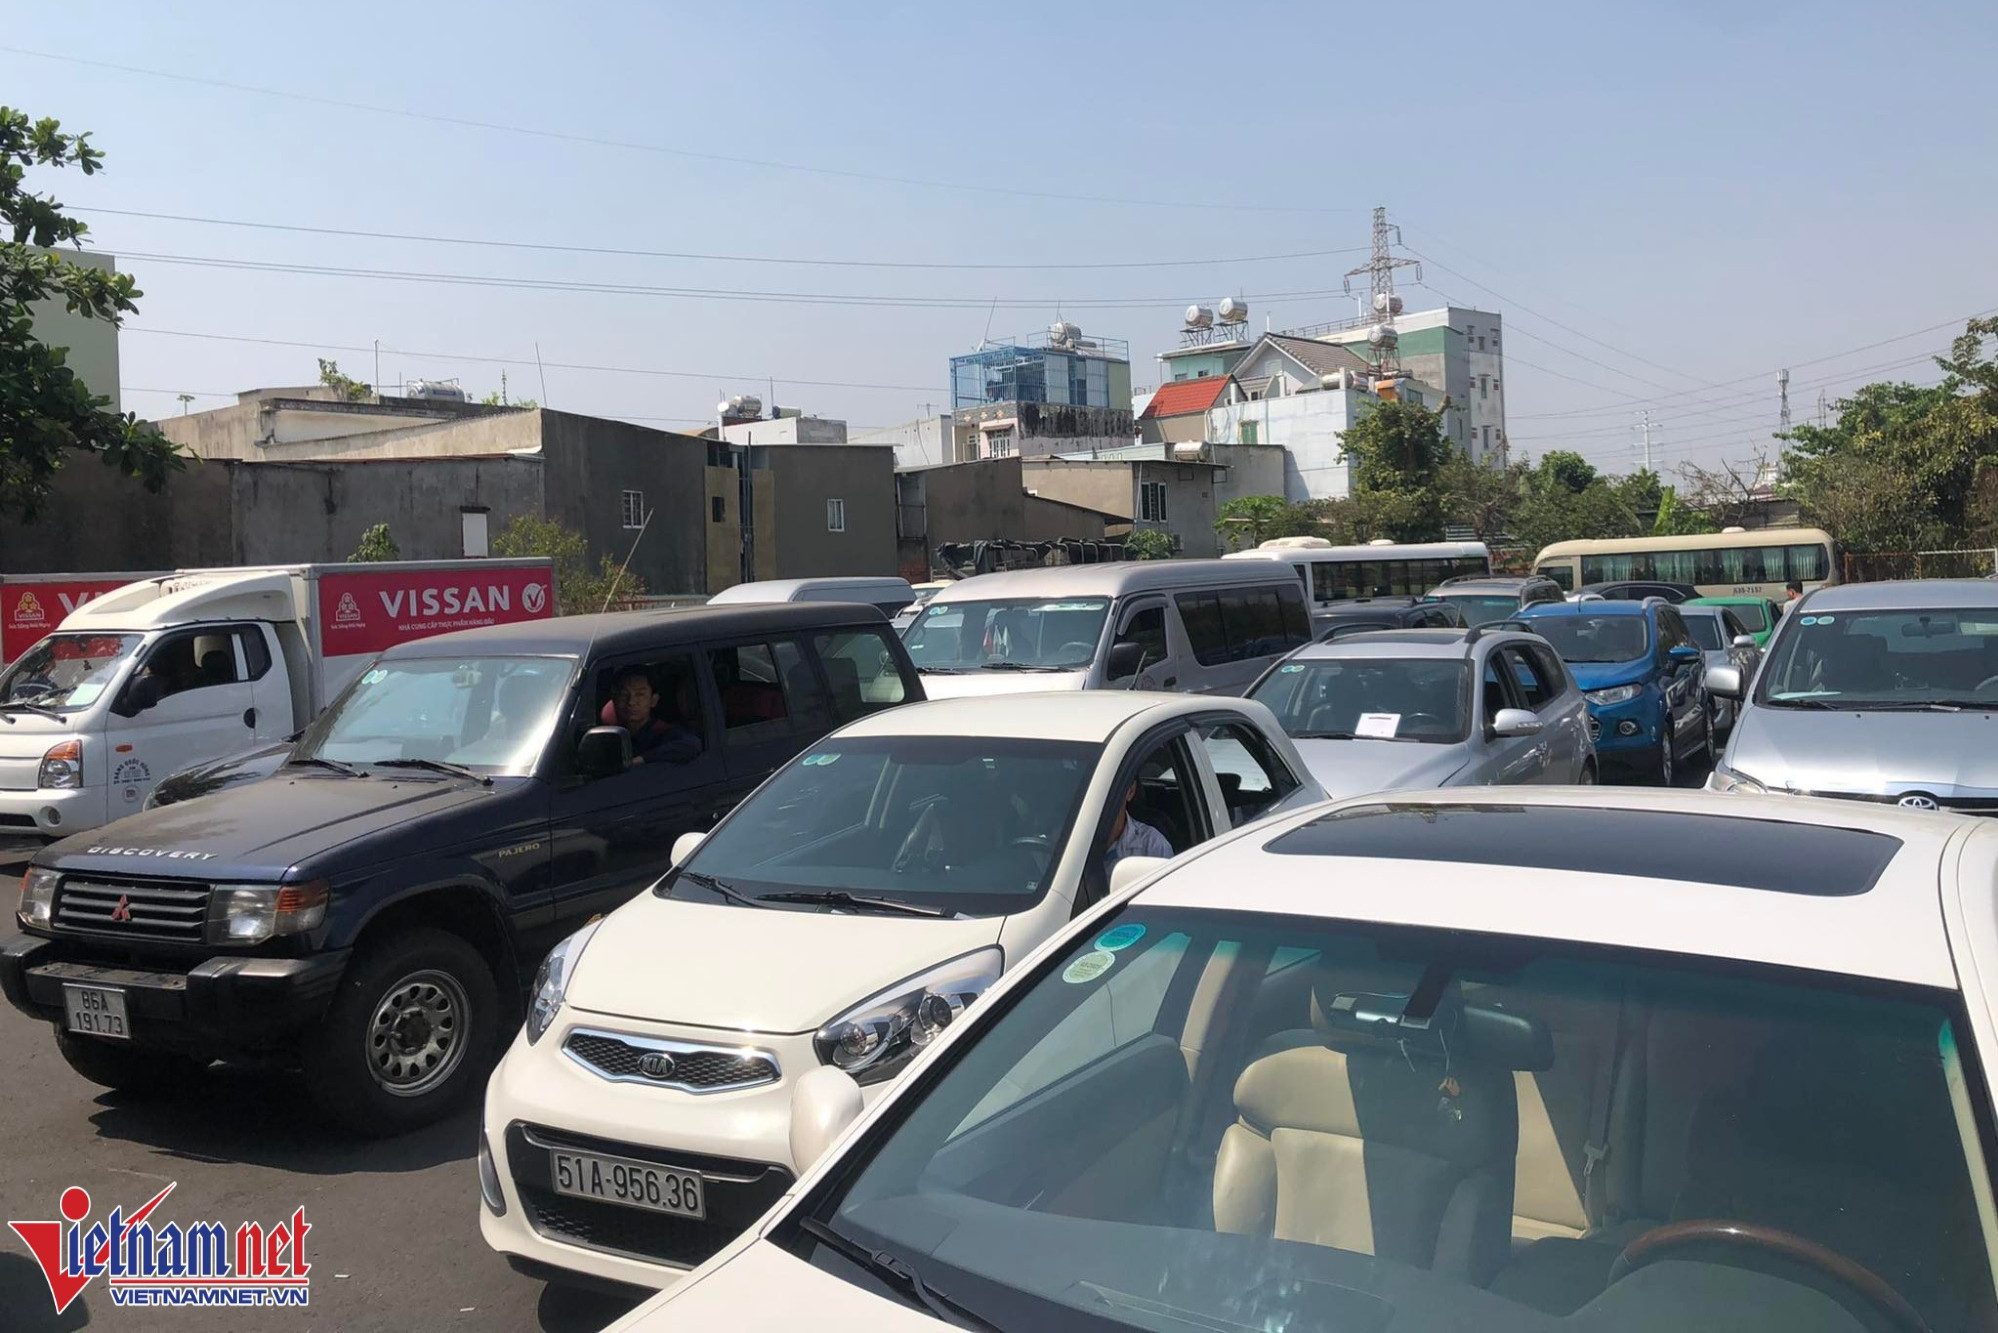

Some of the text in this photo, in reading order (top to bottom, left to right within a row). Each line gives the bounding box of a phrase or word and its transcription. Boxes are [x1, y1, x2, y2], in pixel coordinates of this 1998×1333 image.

[379, 585, 510, 619] VISSAN
[87, 846, 218, 861] DISCOVERY
[498, 842, 540, 858] PAJERO
[81, 991, 109, 1011] 86A
[76, 1011, 123, 1034] 191.73
[642, 1056, 668, 1074] KIA
[557, 1155, 699, 1212] 51A-956.36
